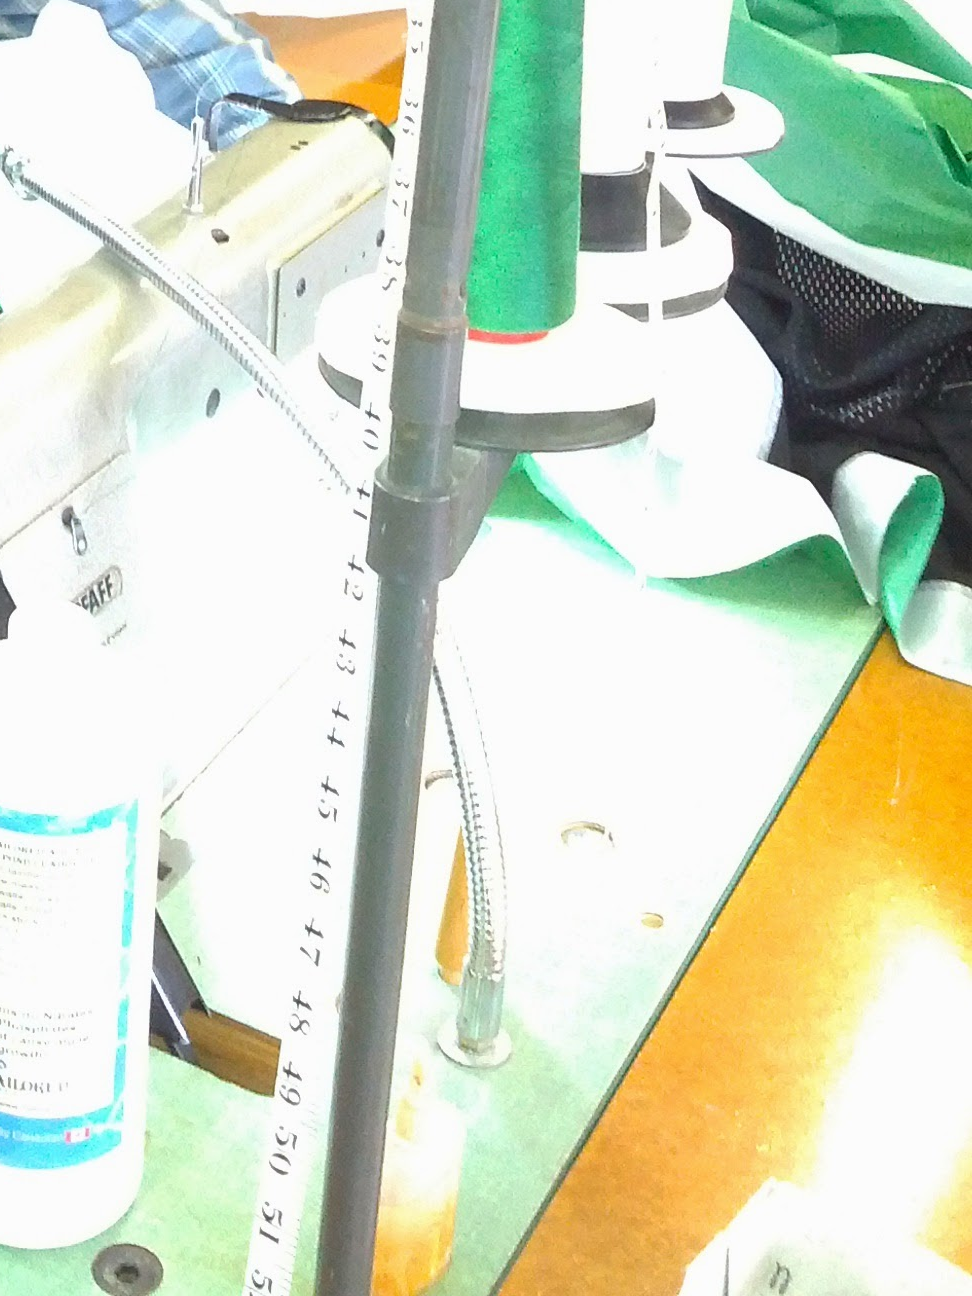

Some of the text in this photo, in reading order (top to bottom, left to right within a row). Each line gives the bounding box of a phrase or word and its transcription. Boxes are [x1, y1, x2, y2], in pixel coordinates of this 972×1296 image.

[393, 177, 411, 218] 37
[75, 573, 113, 614] FAFF
[336, 628, 357, 676] 43
[326, 700, 350, 748] 44
[317, 775, 340, 823] 45
[309, 847, 332, 894] 46
[299, 918, 324, 967] 47
[289, 990, 313, 1036] 48
[277, 1060, 303, 1107] 49
[268, 1125, 298, 1177] 50
[258, 1201, 283, 1245] 51
[249, 1269, 273, 1296] 5
